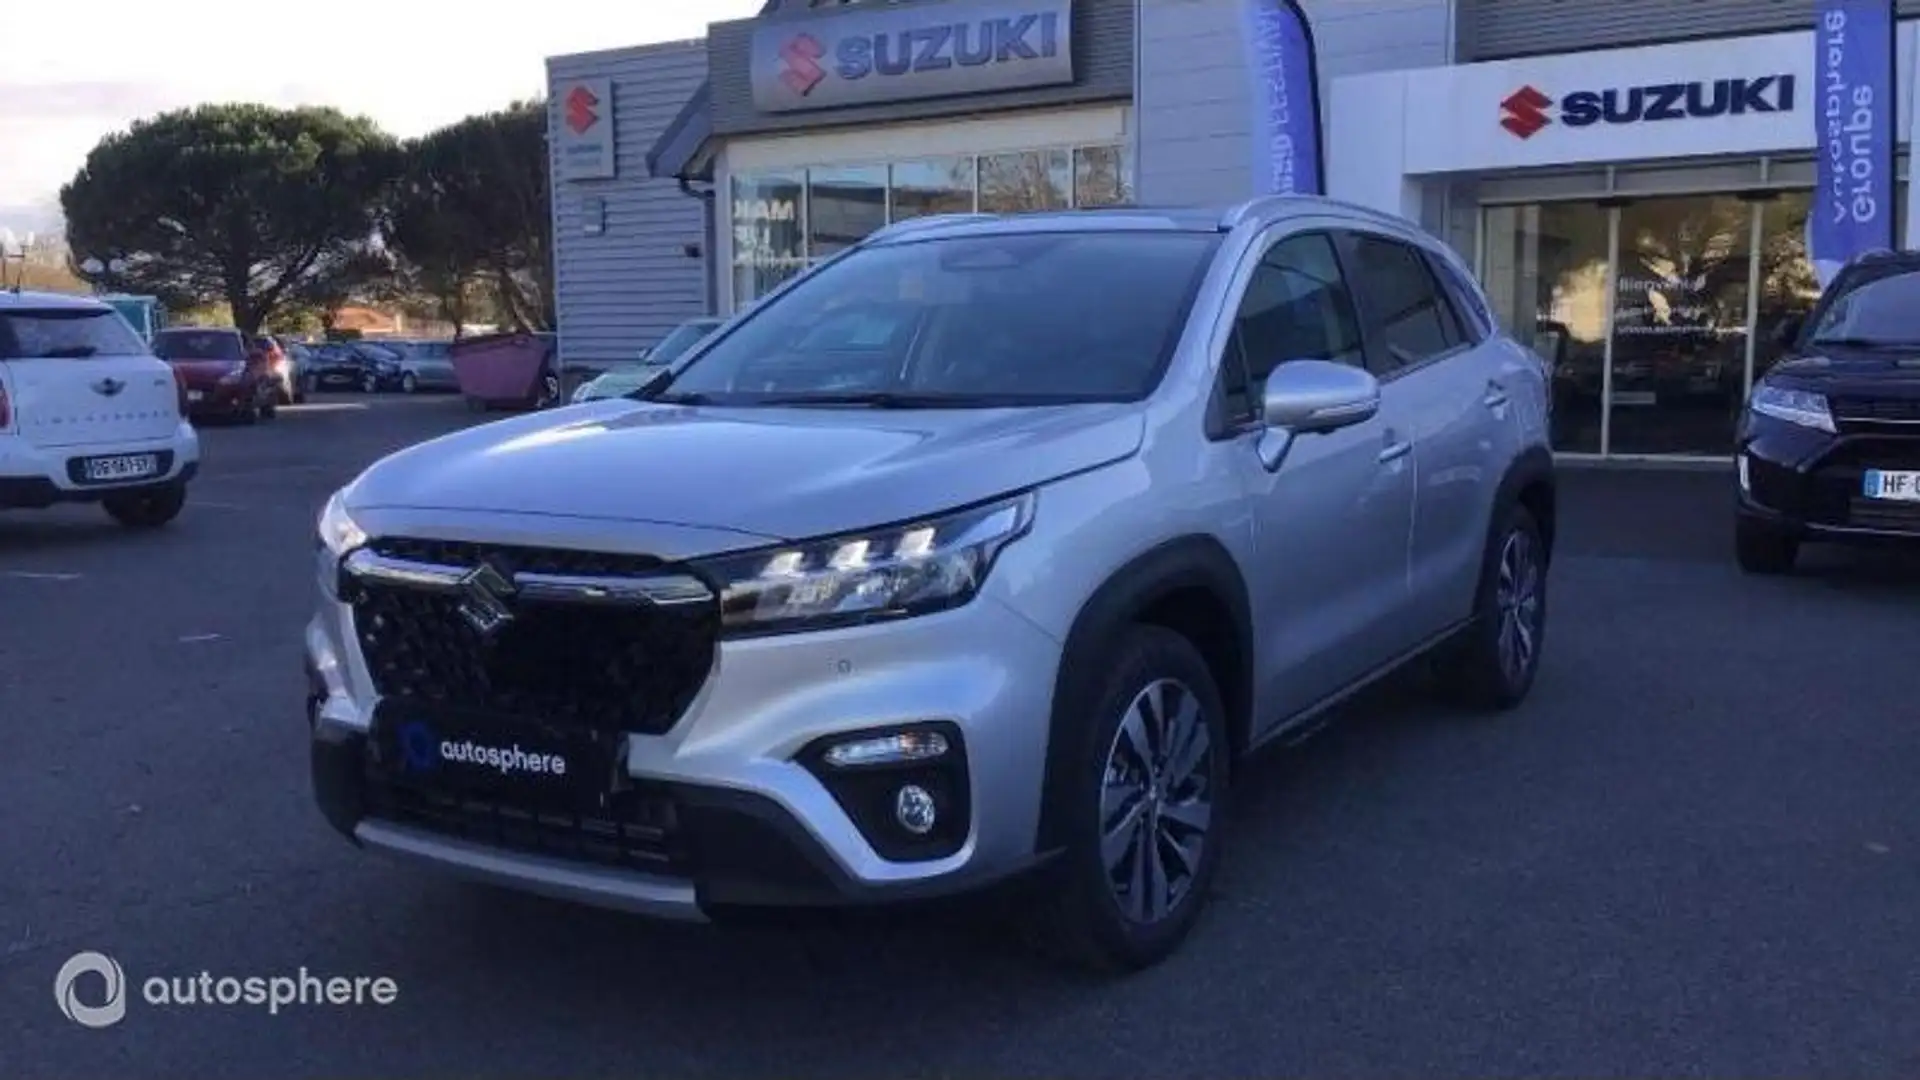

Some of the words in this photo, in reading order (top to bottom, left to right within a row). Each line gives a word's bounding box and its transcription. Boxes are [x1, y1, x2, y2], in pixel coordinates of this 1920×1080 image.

[835, 11, 1058, 80] SUZUKI
[1561, 74, 1795, 127] SUZUKI
[440, 739, 566, 775] autosphere
